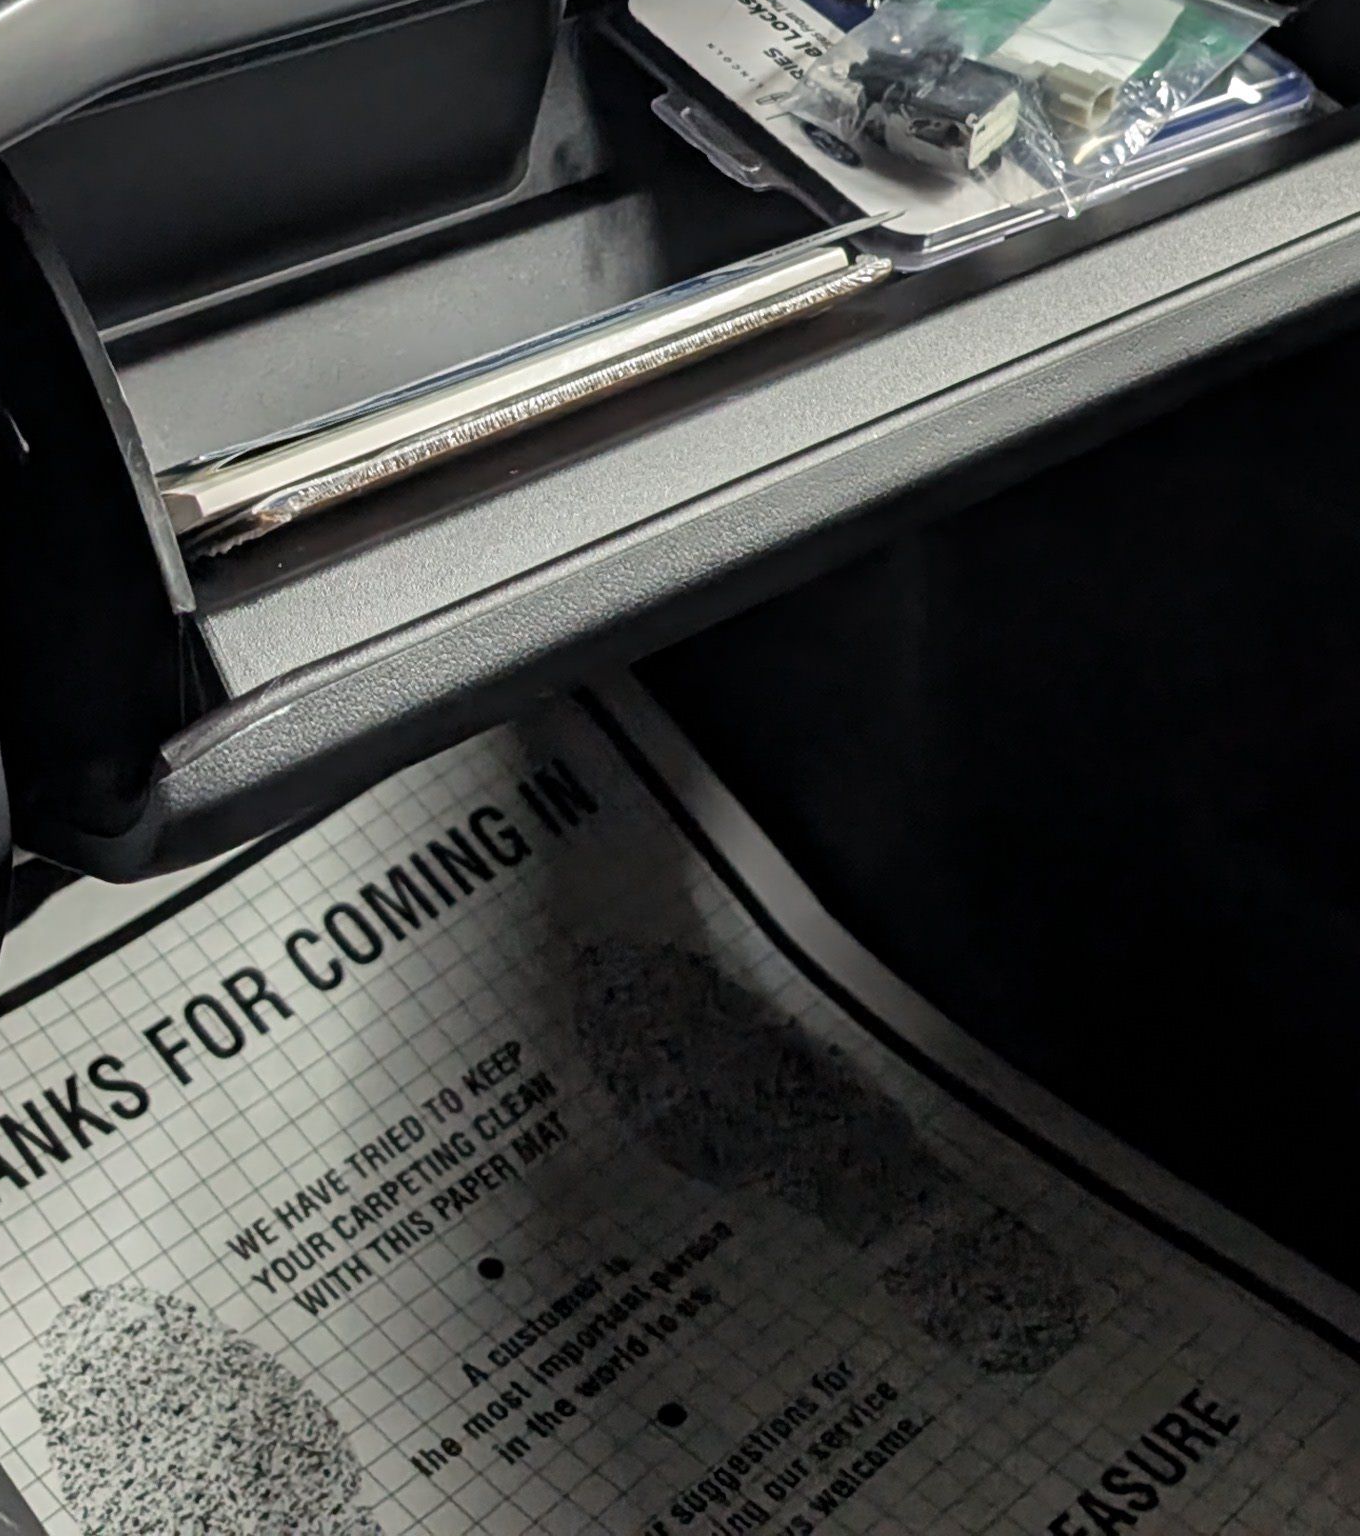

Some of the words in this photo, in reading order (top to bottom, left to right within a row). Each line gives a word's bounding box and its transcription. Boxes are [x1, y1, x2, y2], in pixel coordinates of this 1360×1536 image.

[763, 47, 804, 80] RIES
[793, 41, 823, 58] el
[145, 966, 295, 1087] FOR
[285, 805, 533, 993] COMING
[518, 757, 599, 837] IN
[226, 1218, 279, 1261] WE
[273, 1168, 349, 1230] HAVE
[344, 1115, 426, 1179] TRIED
[422, 1088, 463, 1123] TO
[462, 1041, 521, 1097] KEEP
[252, 1233, 335, 1294] YOUR
[331, 1132, 476, 1241] CARPETING
[474, 1072, 556, 1141] CLEAN
[294, 1254, 373, 1316] WITH
[366, 1210, 434, 1263] THIS
[430, 1154, 521, 1221] PAPER
[511, 1111, 568, 1165] MAT
[461, 1363, 489, 1387] A
[488, 1273, 603, 1368] customer
[492, 1437, 531, 1464] in
[527, 1399, 577, 1438] the
[574, 1334, 649, 1397] world
[644, 1314, 678, 1342] to
[410, 1437, 462, 1478] the
[462, 1380, 531, 1439] most
[670, 1396, 819, 1525] suggestions
[811, 1361, 853, 1399] for
[763, 1459, 809, 1501] our
[808, 1381, 899, 1460] service
